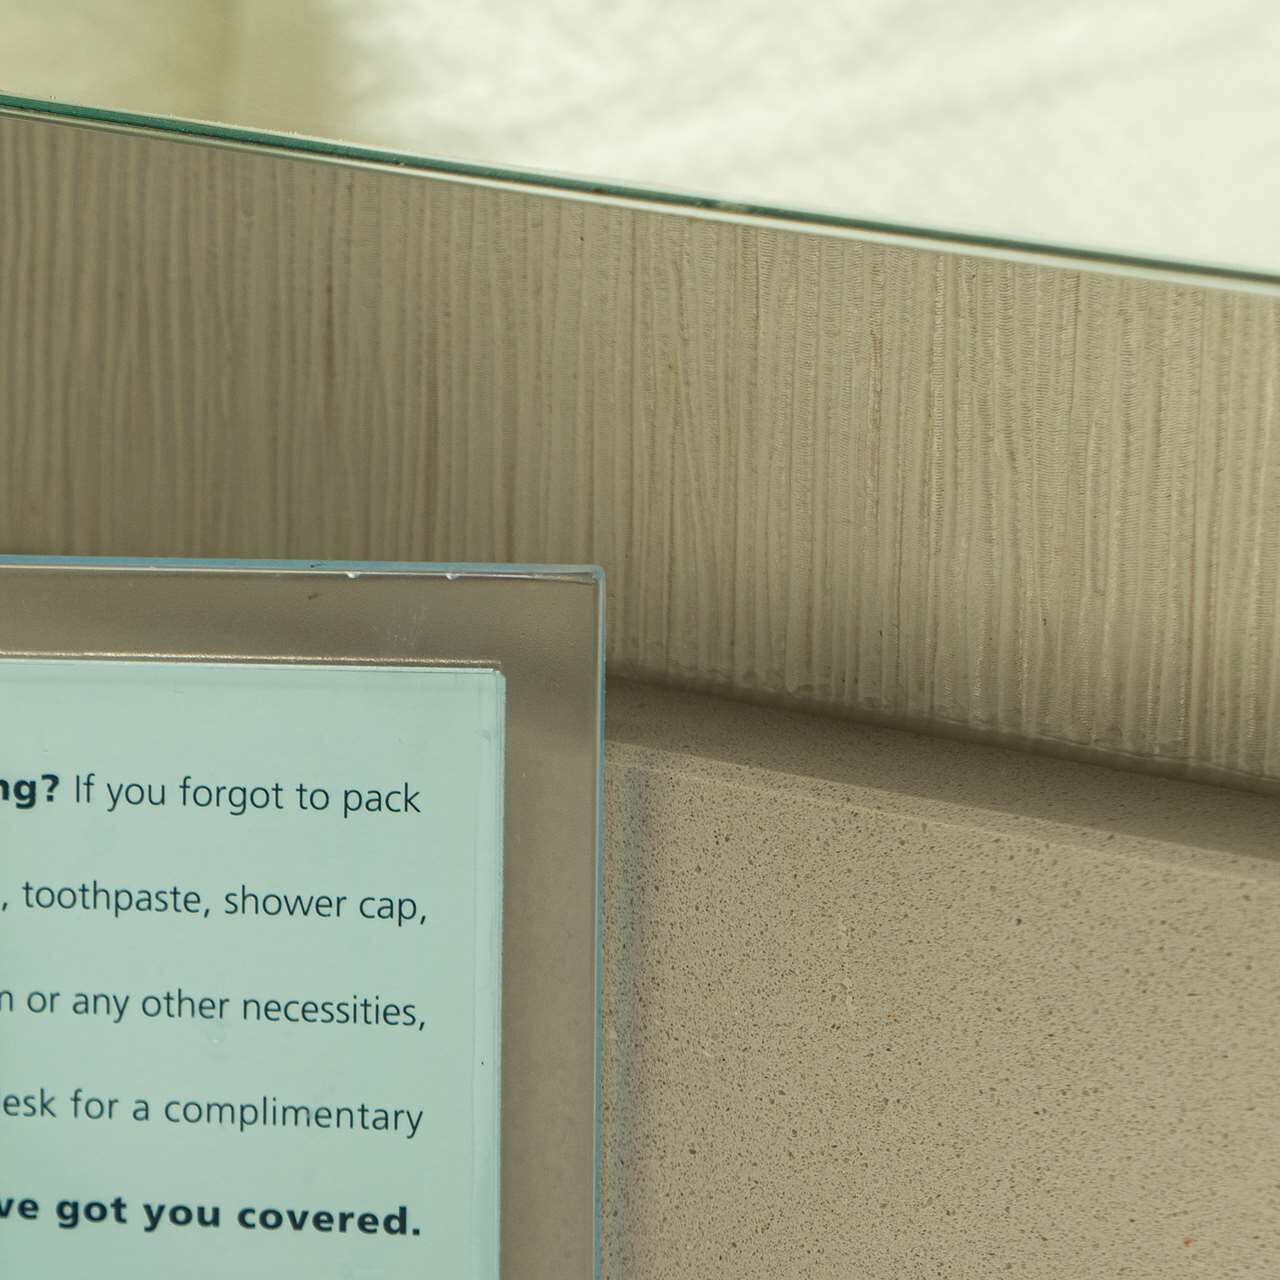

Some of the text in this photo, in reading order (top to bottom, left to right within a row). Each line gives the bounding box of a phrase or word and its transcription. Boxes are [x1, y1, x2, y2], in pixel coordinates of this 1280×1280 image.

[75, 773, 95, 803] If
[107, 782, 166, 812] you
[179, 775, 283, 815] forgot
[296, 783, 329, 810] to
[343, 783, 421, 818] pack
[22, 880, 211, 918] toothpaste,
[224, 885, 347, 917] shower
[359, 896, 427, 927] cap,
[27, 990, 60, 1013] or
[73, 992, 130, 1023] any
[142, 988, 229, 1018] other
[243, 994, 425, 1030] necessities,
[70, 1089, 118, 1119] for
[132, 1099, 149, 1121] a
[164, 1096, 423, 1139] complimentary
[56, 1196, 127, 1229] got
[143, 1202, 220, 1232] you
[237, 1206, 420, 1235] covered.
